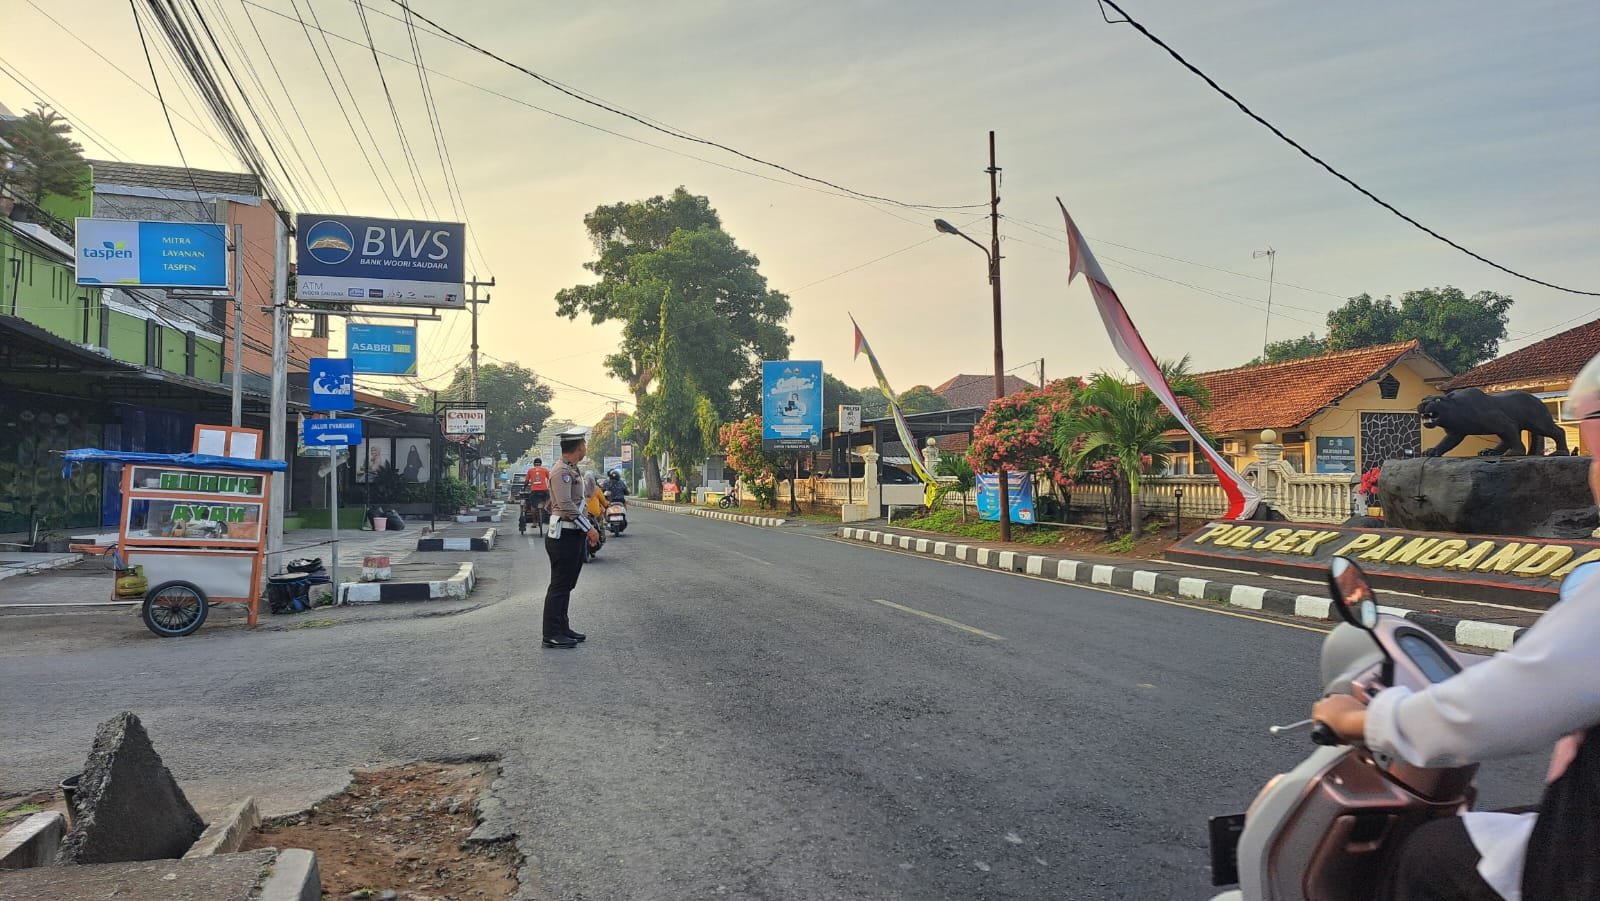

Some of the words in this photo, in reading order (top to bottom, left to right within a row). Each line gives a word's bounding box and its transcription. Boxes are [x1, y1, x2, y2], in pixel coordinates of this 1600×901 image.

[162, 236, 191, 245] MITRA
[361, 226, 451, 261] BWS
[83, 247, 133, 260] taspen
[162, 250, 205, 258] LAYANAN
[163, 263, 197, 271] TASPEN
[360, 258, 381, 266] BANK
[383, 260, 411, 268] WOORI
[412, 261, 448, 270] SAUDARA
[302, 281, 323, 290] ATM
[352, 342, 391, 352] ASABRI
[447, 411, 483, 420] Canon
[171, 504, 245, 522] AYAM
[1194, 522, 1340, 556] POLSEK
[1332, 533, 1600, 581] PANGAND
